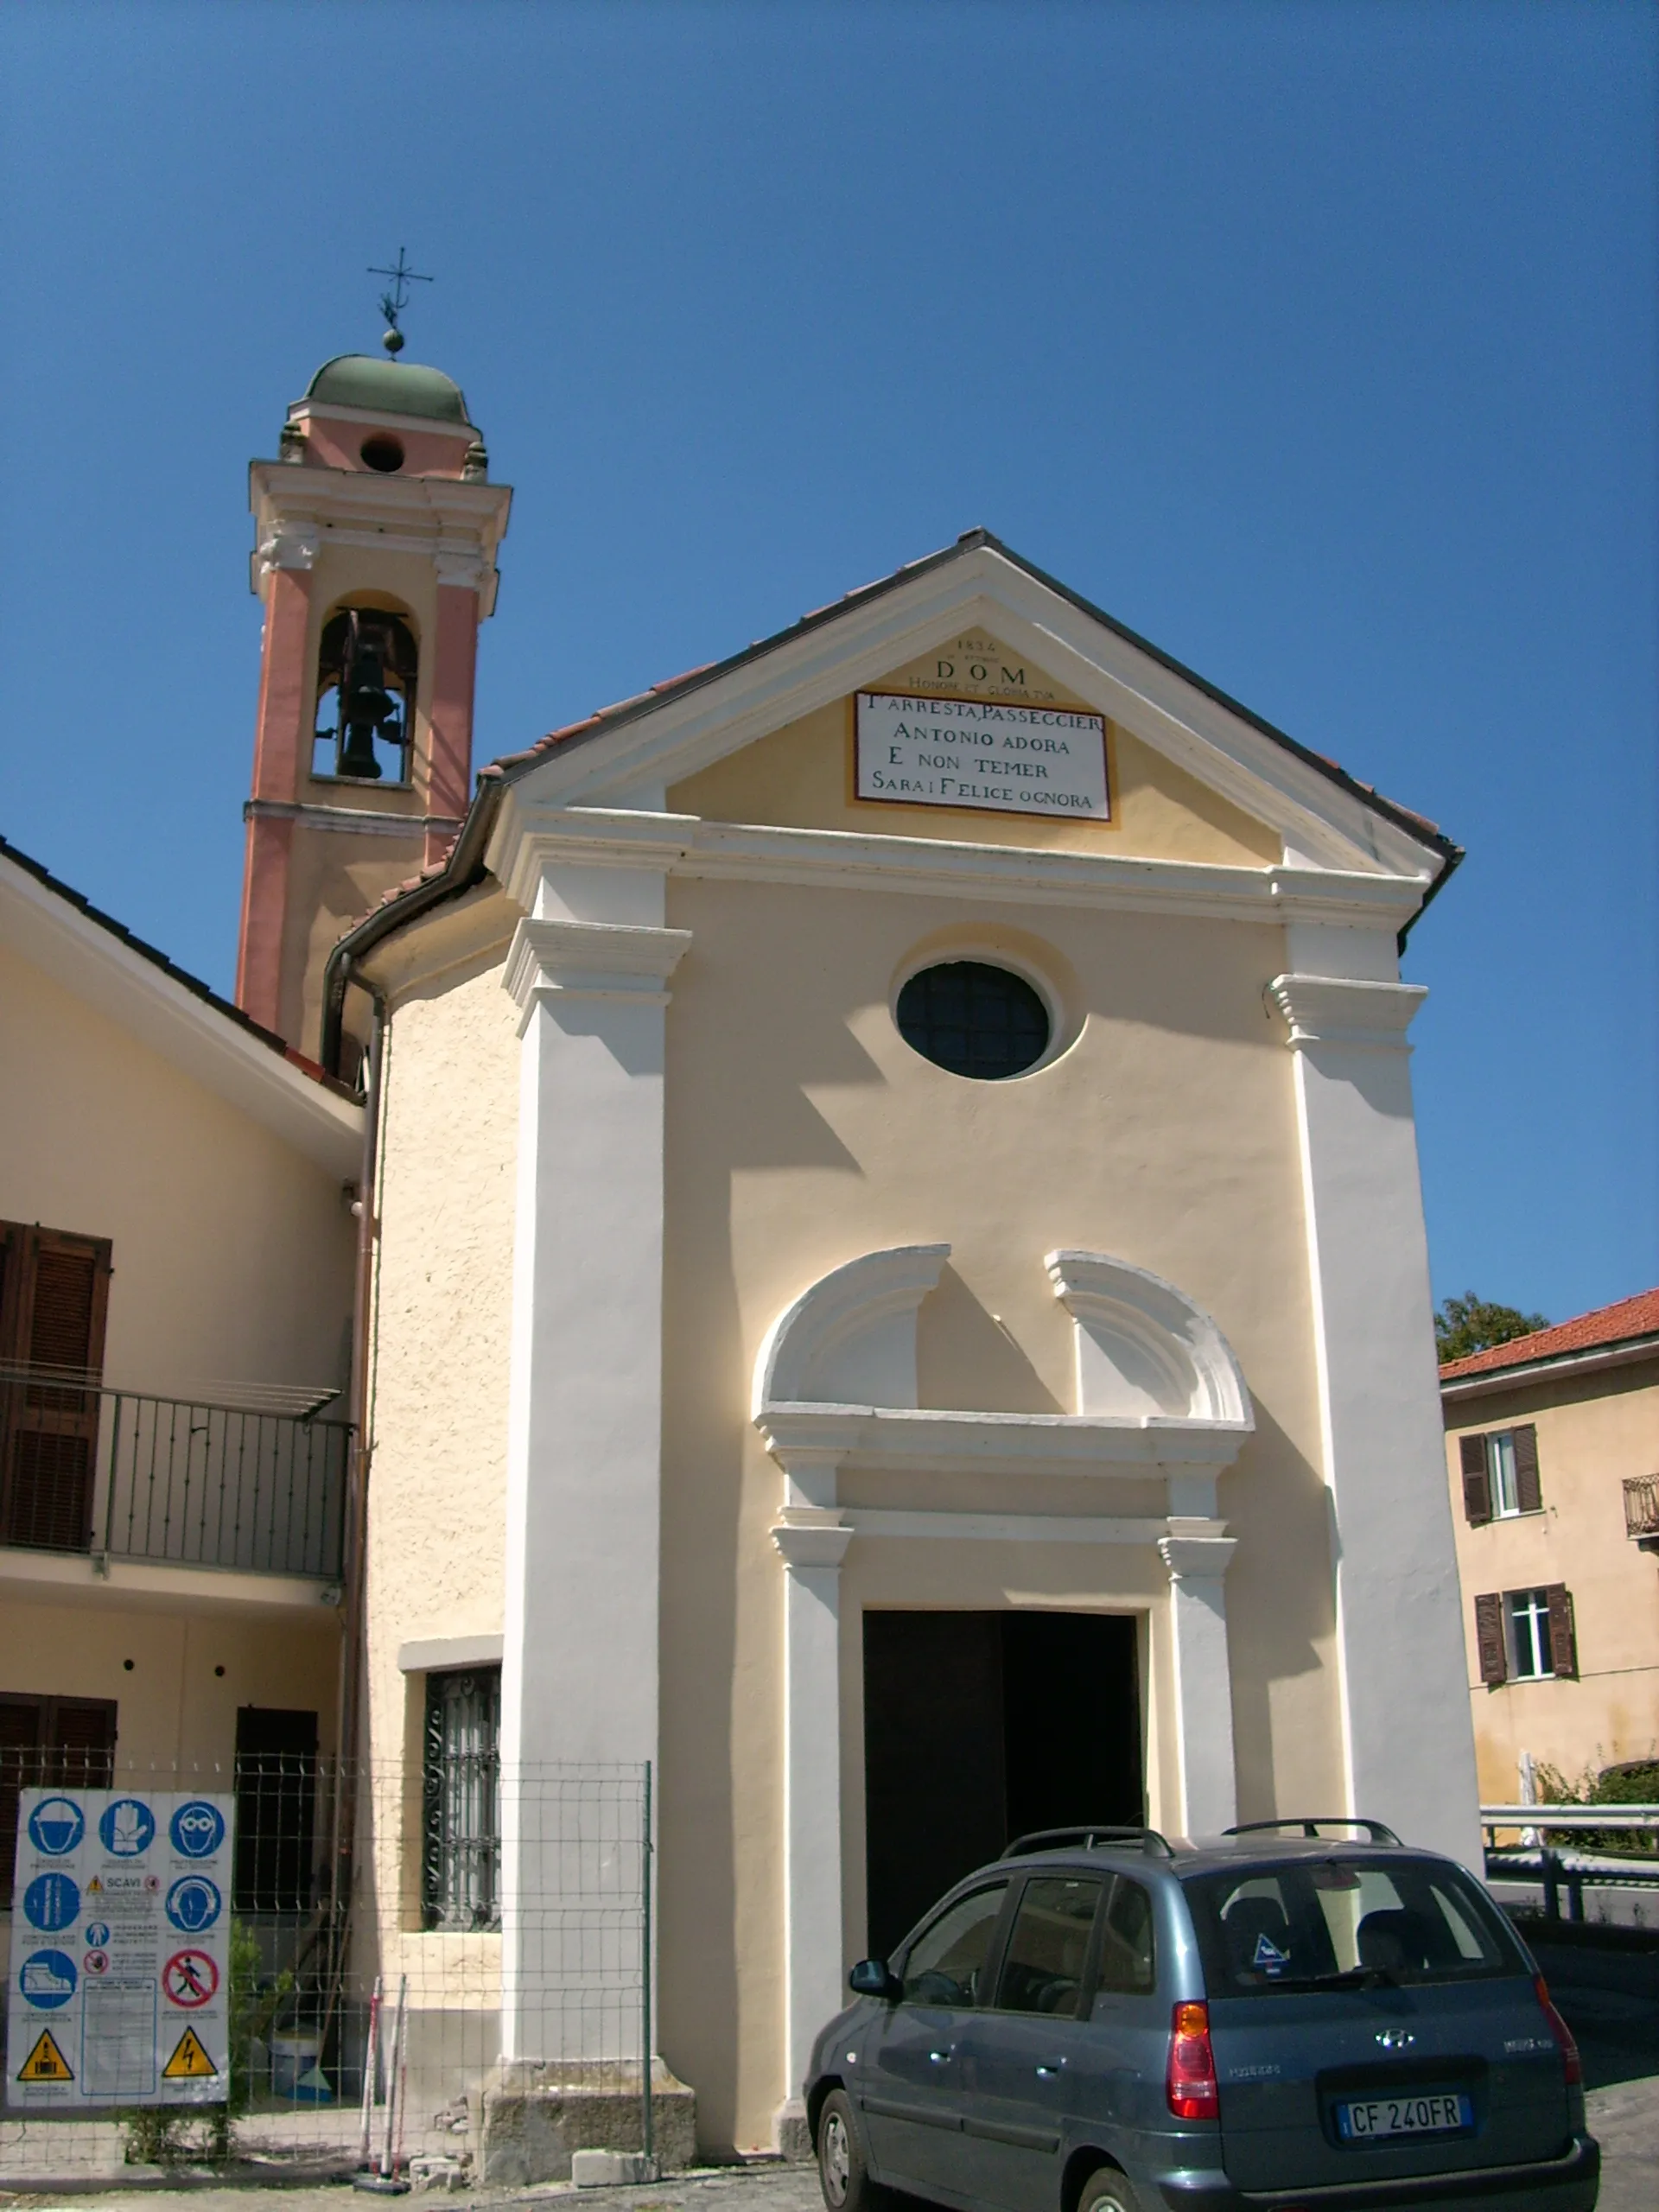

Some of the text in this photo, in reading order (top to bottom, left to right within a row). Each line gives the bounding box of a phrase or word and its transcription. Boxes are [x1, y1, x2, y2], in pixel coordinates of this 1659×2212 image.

[893, 722, 1070, 754] ANTONIO ADORA
[888, 747, 1049, 778] E NON TEMER
[940, 778, 1014, 801] FELICE
[107, 1878, 141, 1887] SCAVI
[1353, 2099, 1459, 2133] CF 240FR
